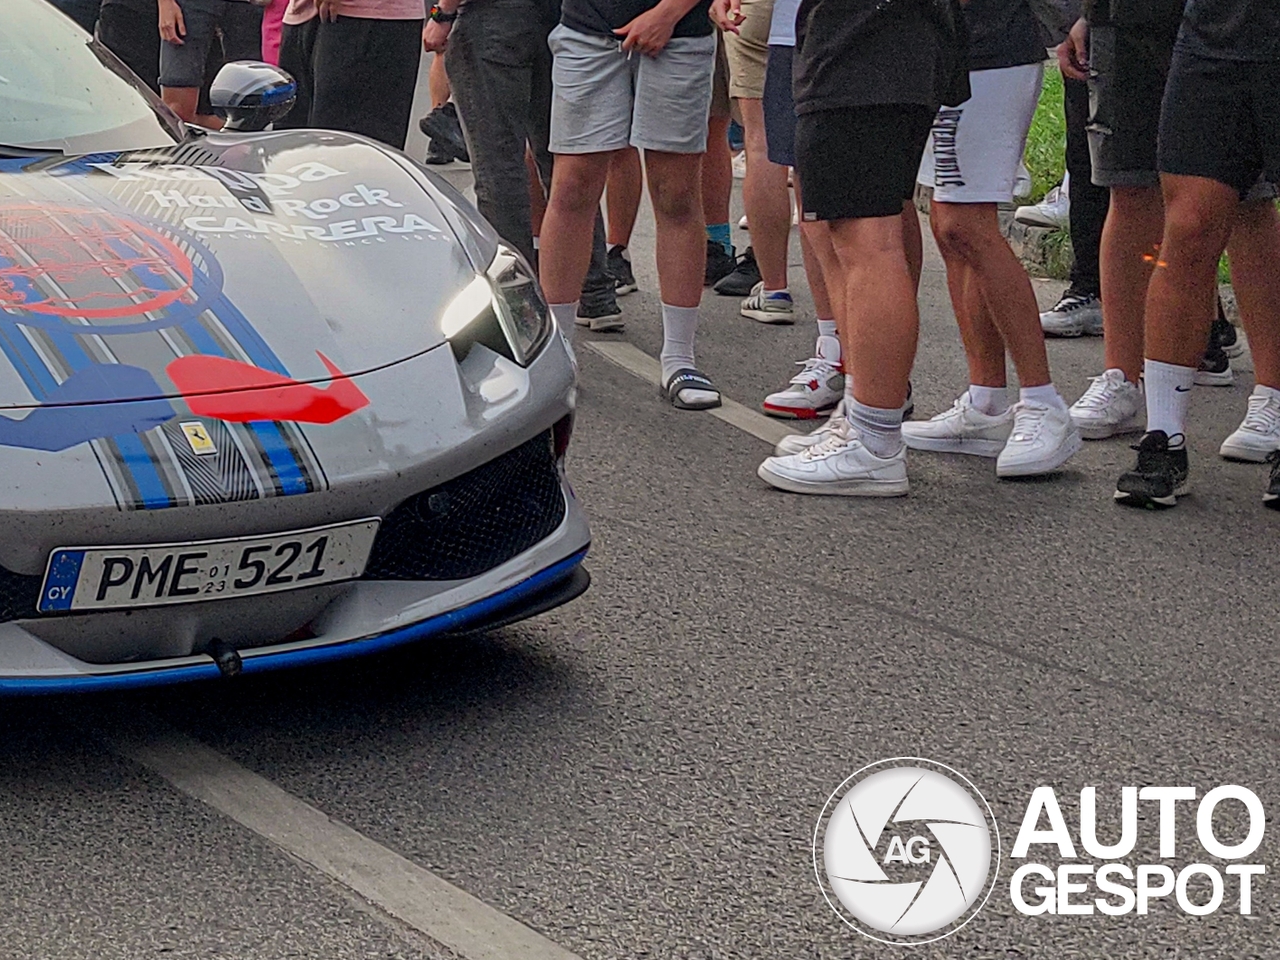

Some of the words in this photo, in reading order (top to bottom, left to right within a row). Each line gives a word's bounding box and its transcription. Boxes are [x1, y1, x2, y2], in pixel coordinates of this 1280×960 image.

[144, 190, 274, 215] Hard
[273, 184, 404, 219] Rock
[183, 213, 442, 240] CARRERA
[95, 551, 208, 602] PME
[233, 536, 330, 589] 521
[209, 564, 231, 578] 01
[47, 586, 72, 601] CY
[204, 579, 226, 593] 23
